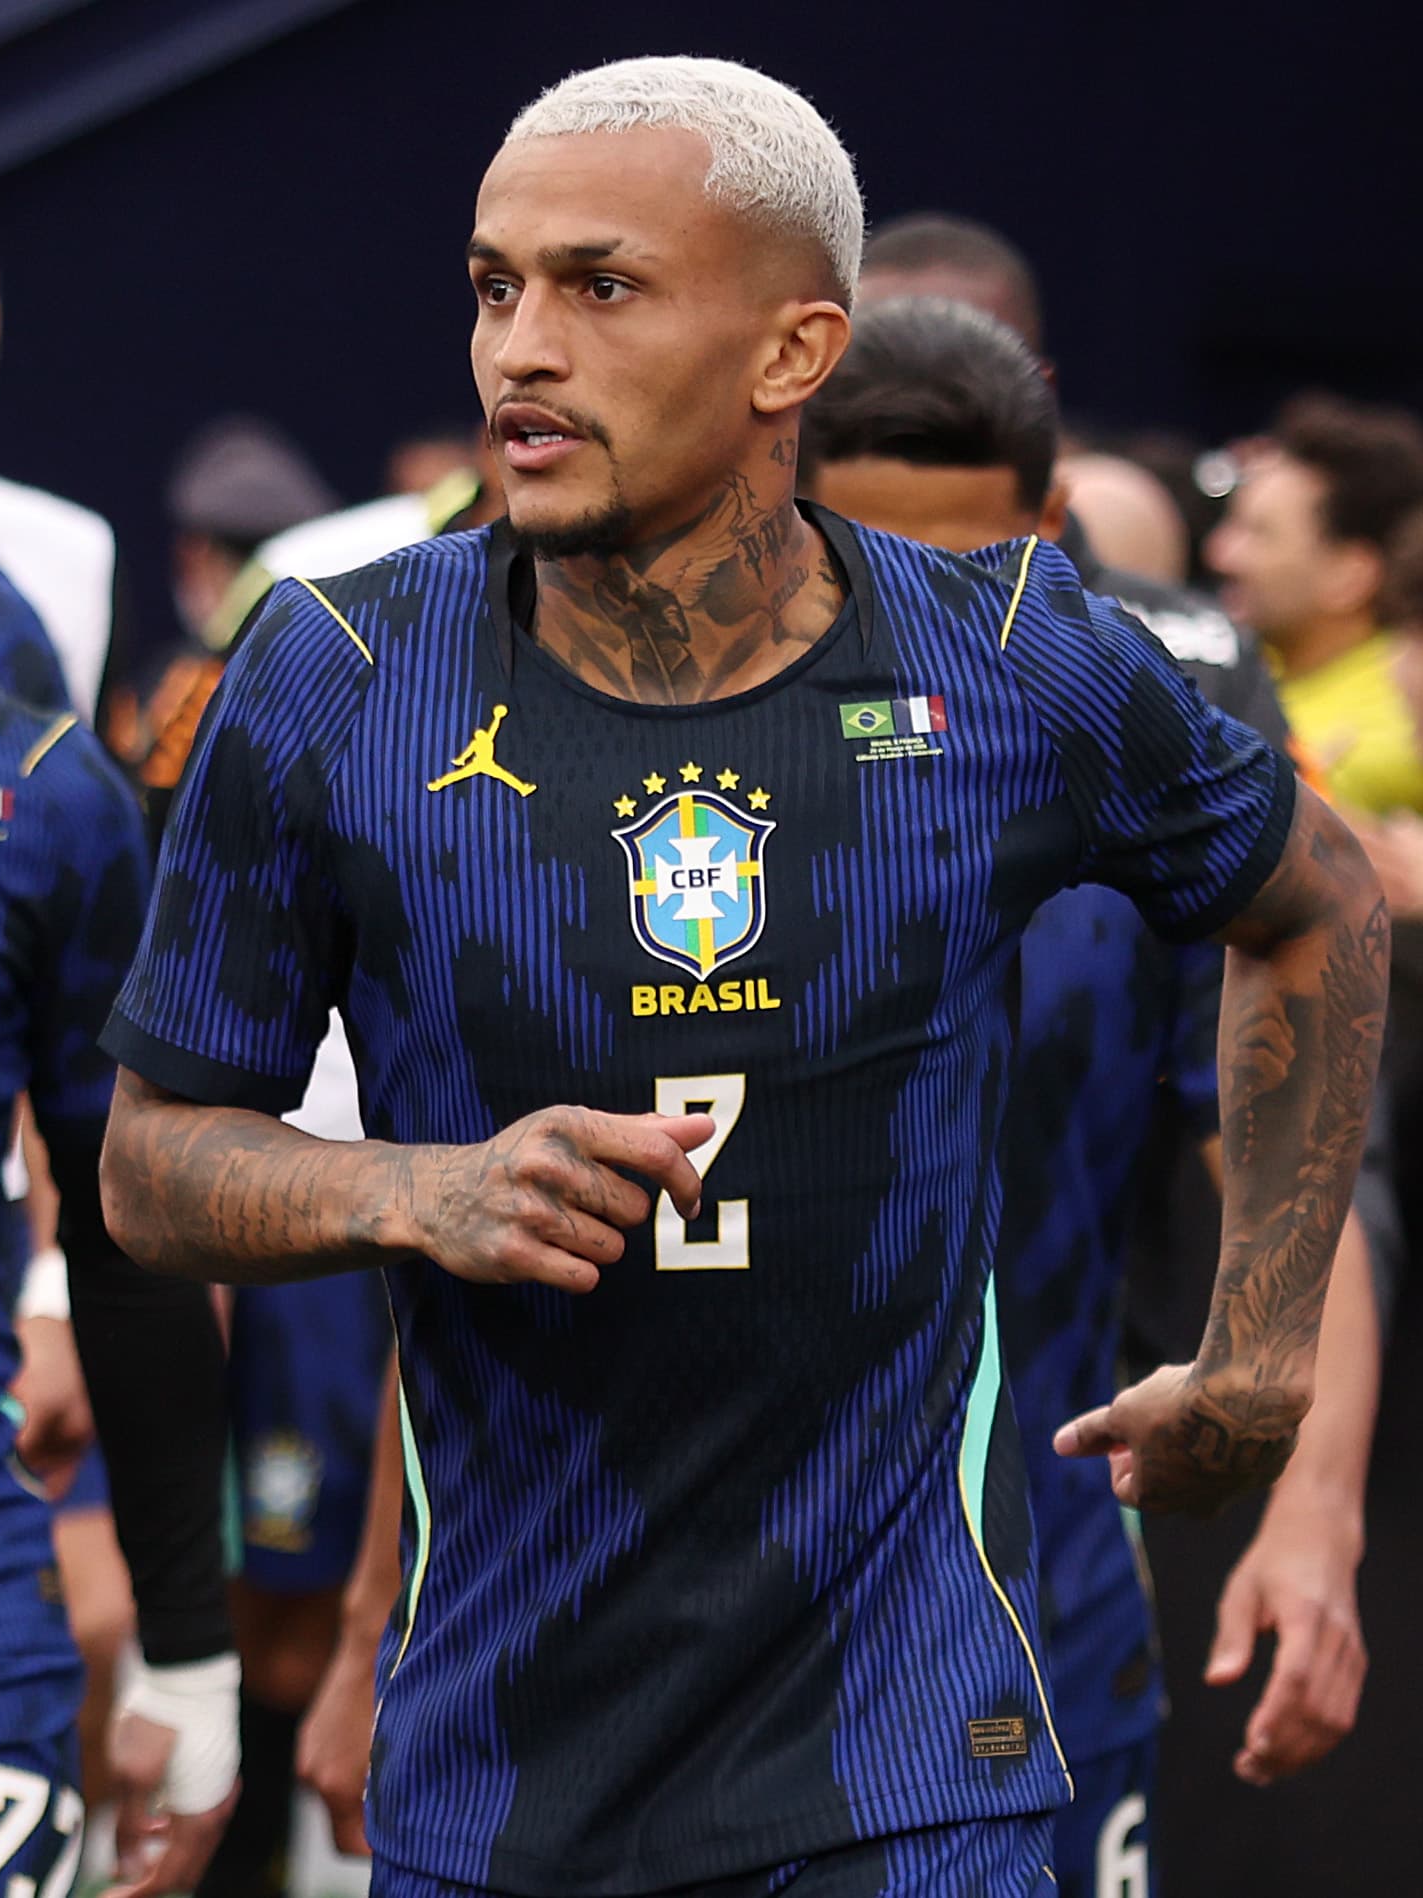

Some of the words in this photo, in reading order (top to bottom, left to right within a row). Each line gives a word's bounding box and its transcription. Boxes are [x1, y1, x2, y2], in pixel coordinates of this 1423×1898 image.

[671, 868, 722, 889] CBF
[631, 978, 782, 1017] BRASIL
[655, 1073, 750, 1271] 2
